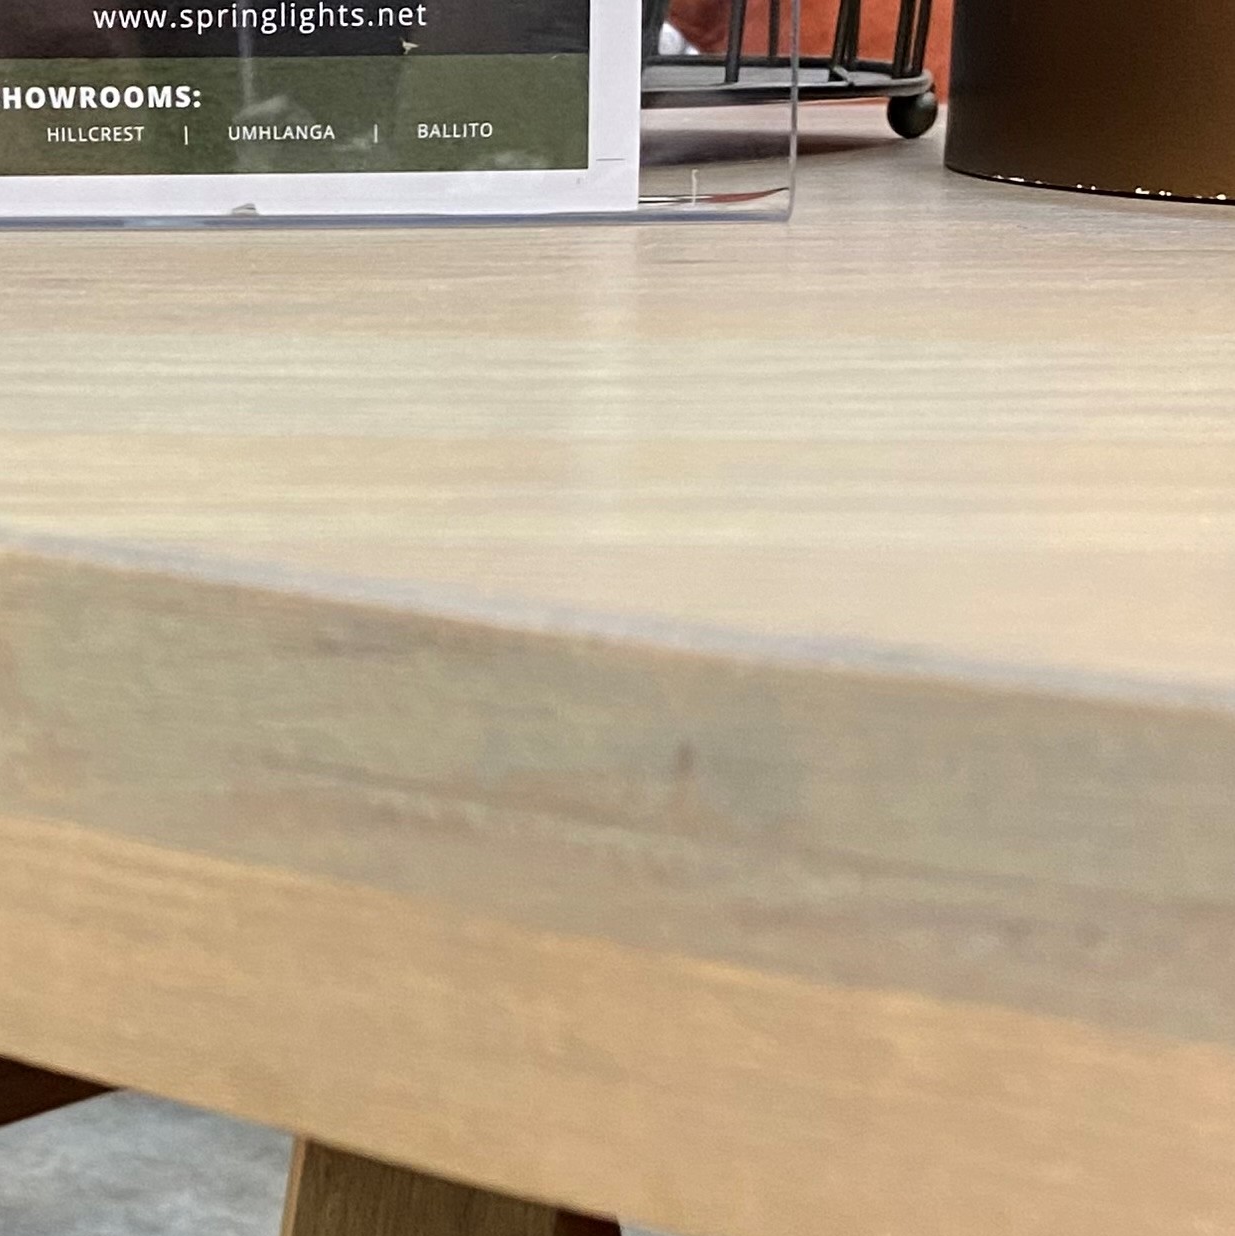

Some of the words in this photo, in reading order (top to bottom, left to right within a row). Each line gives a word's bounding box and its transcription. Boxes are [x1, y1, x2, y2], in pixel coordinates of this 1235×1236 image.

[92, 3, 428, 35] www.springlights.net
[46, 126, 145, 143] HILLCREST
[227, 124, 336, 141] UMHLANGA
[416, 122, 494, 139] BALLITO
